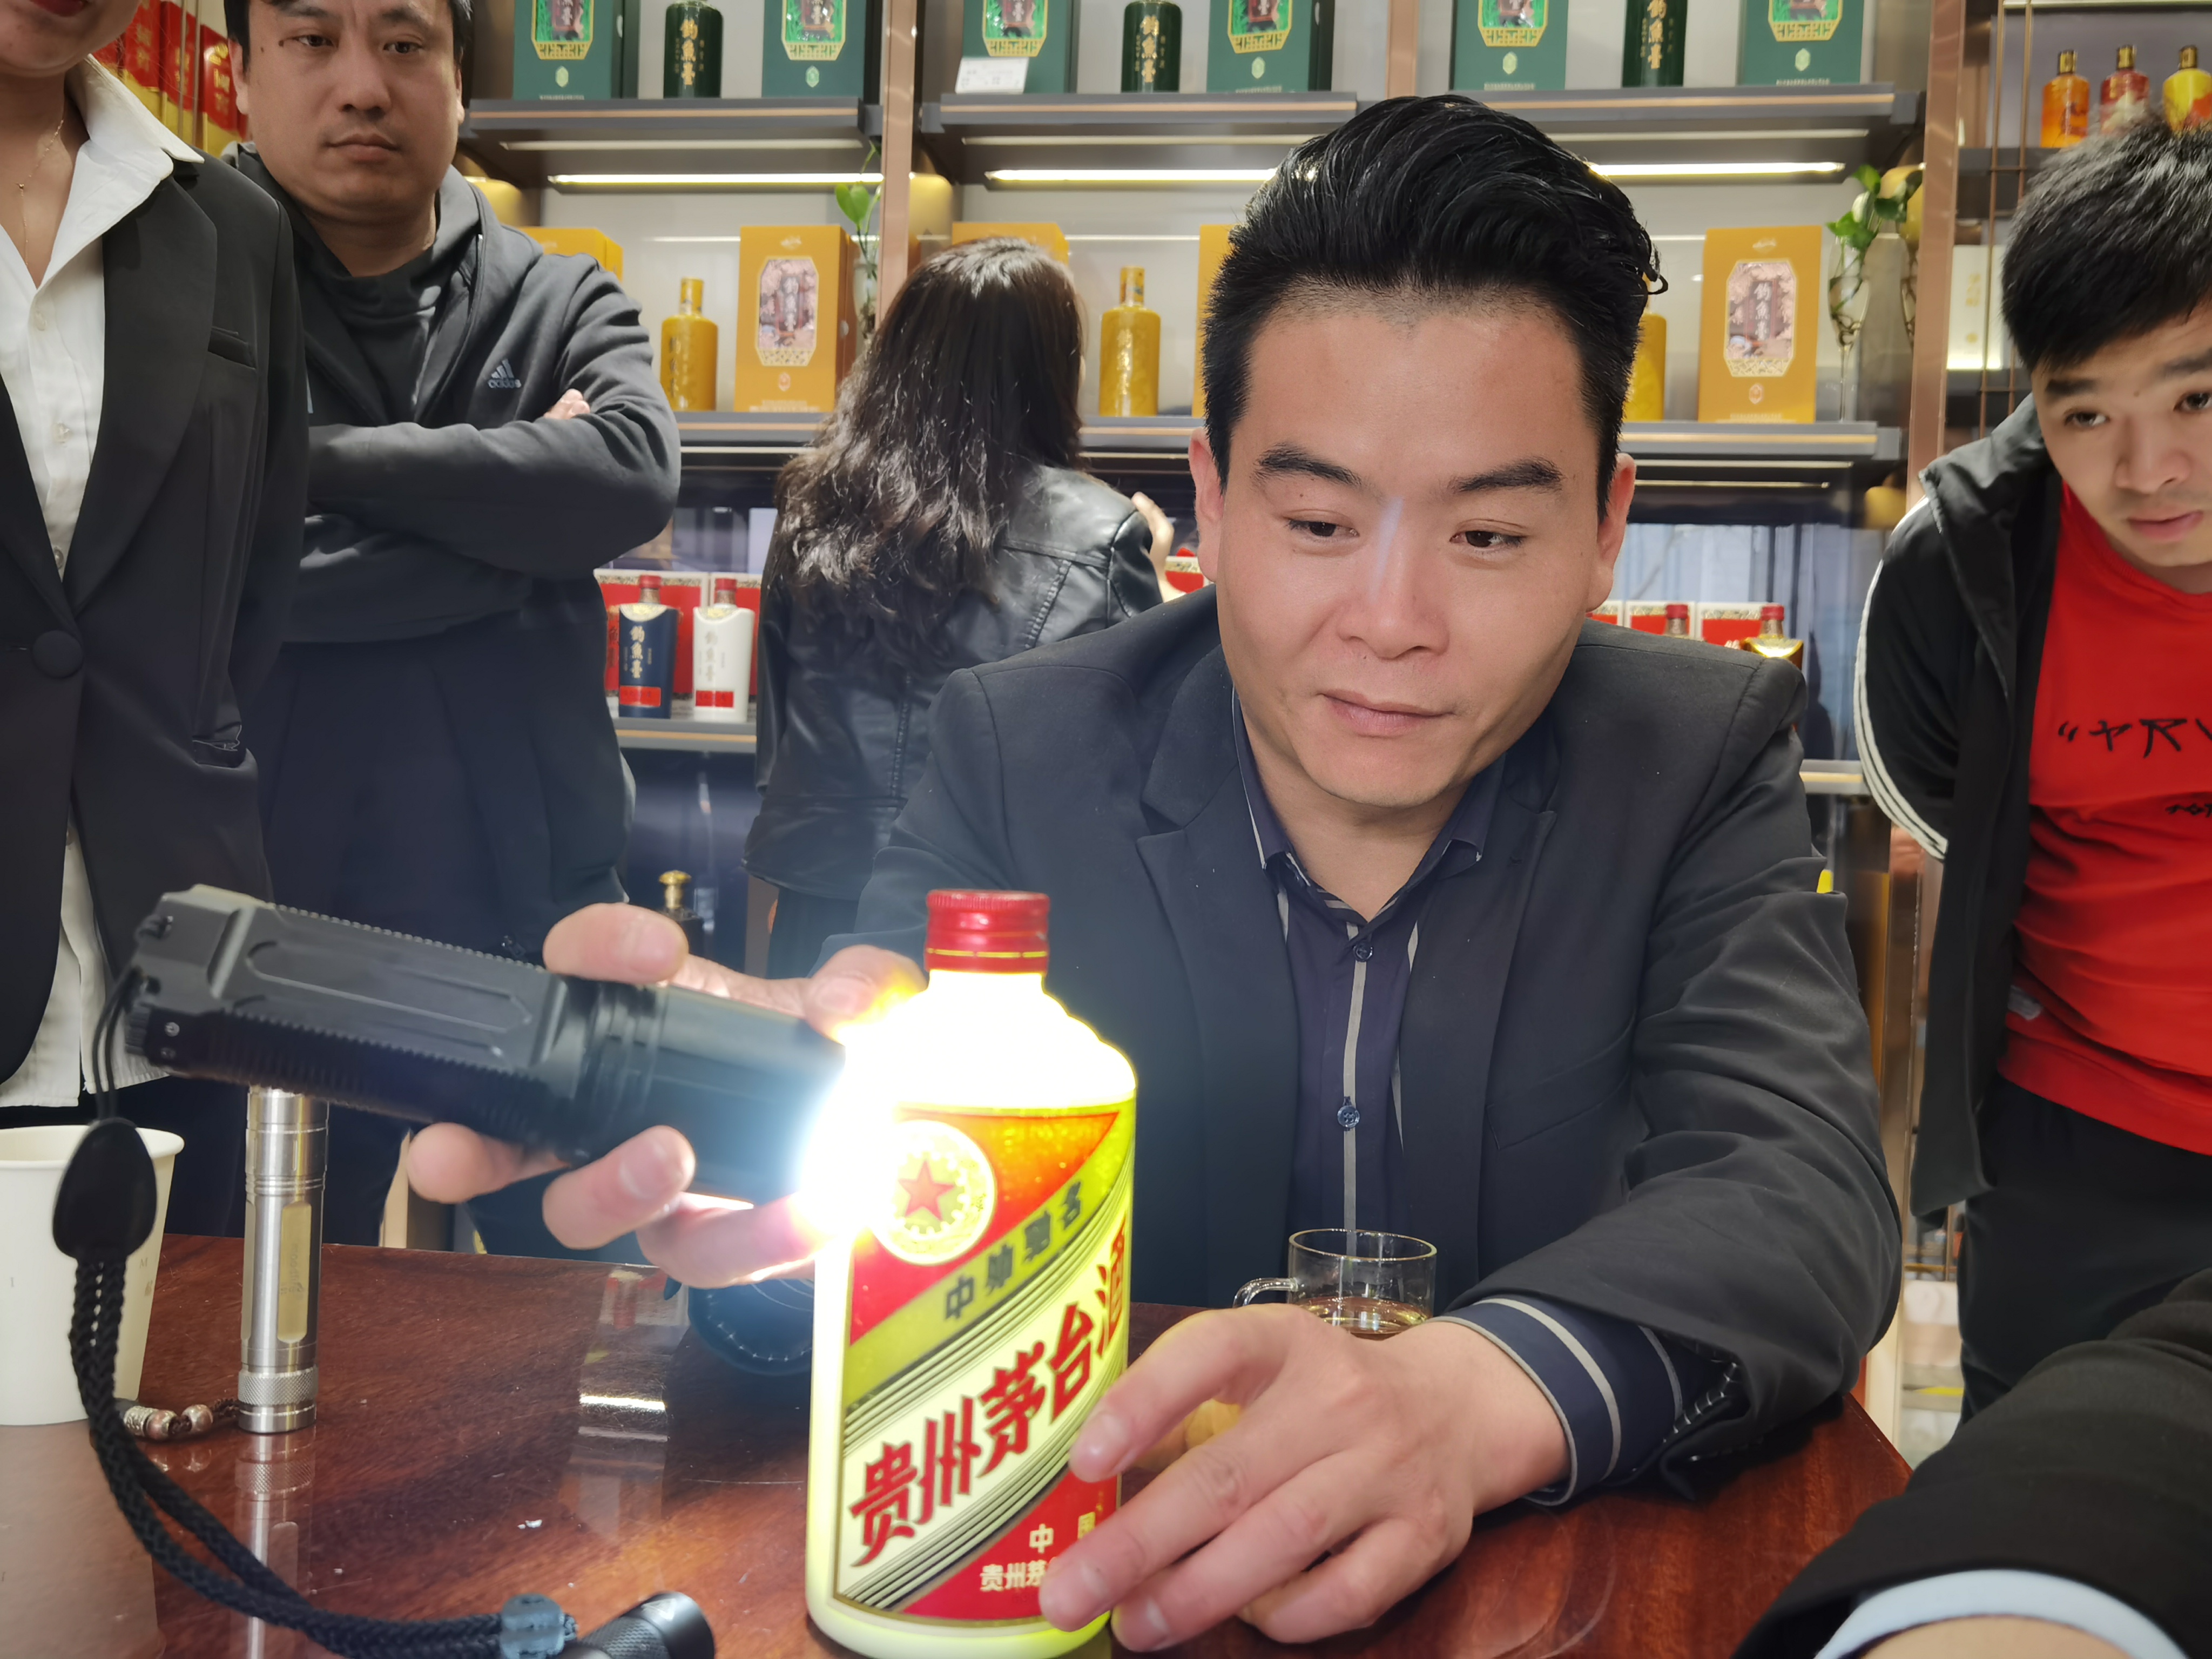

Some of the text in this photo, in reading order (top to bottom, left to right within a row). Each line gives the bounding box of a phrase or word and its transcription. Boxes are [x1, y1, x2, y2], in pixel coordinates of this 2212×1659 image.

[487, 377, 522, 388] adidas
[848, 1214, 1127, 1567] 贵州茅台酒
